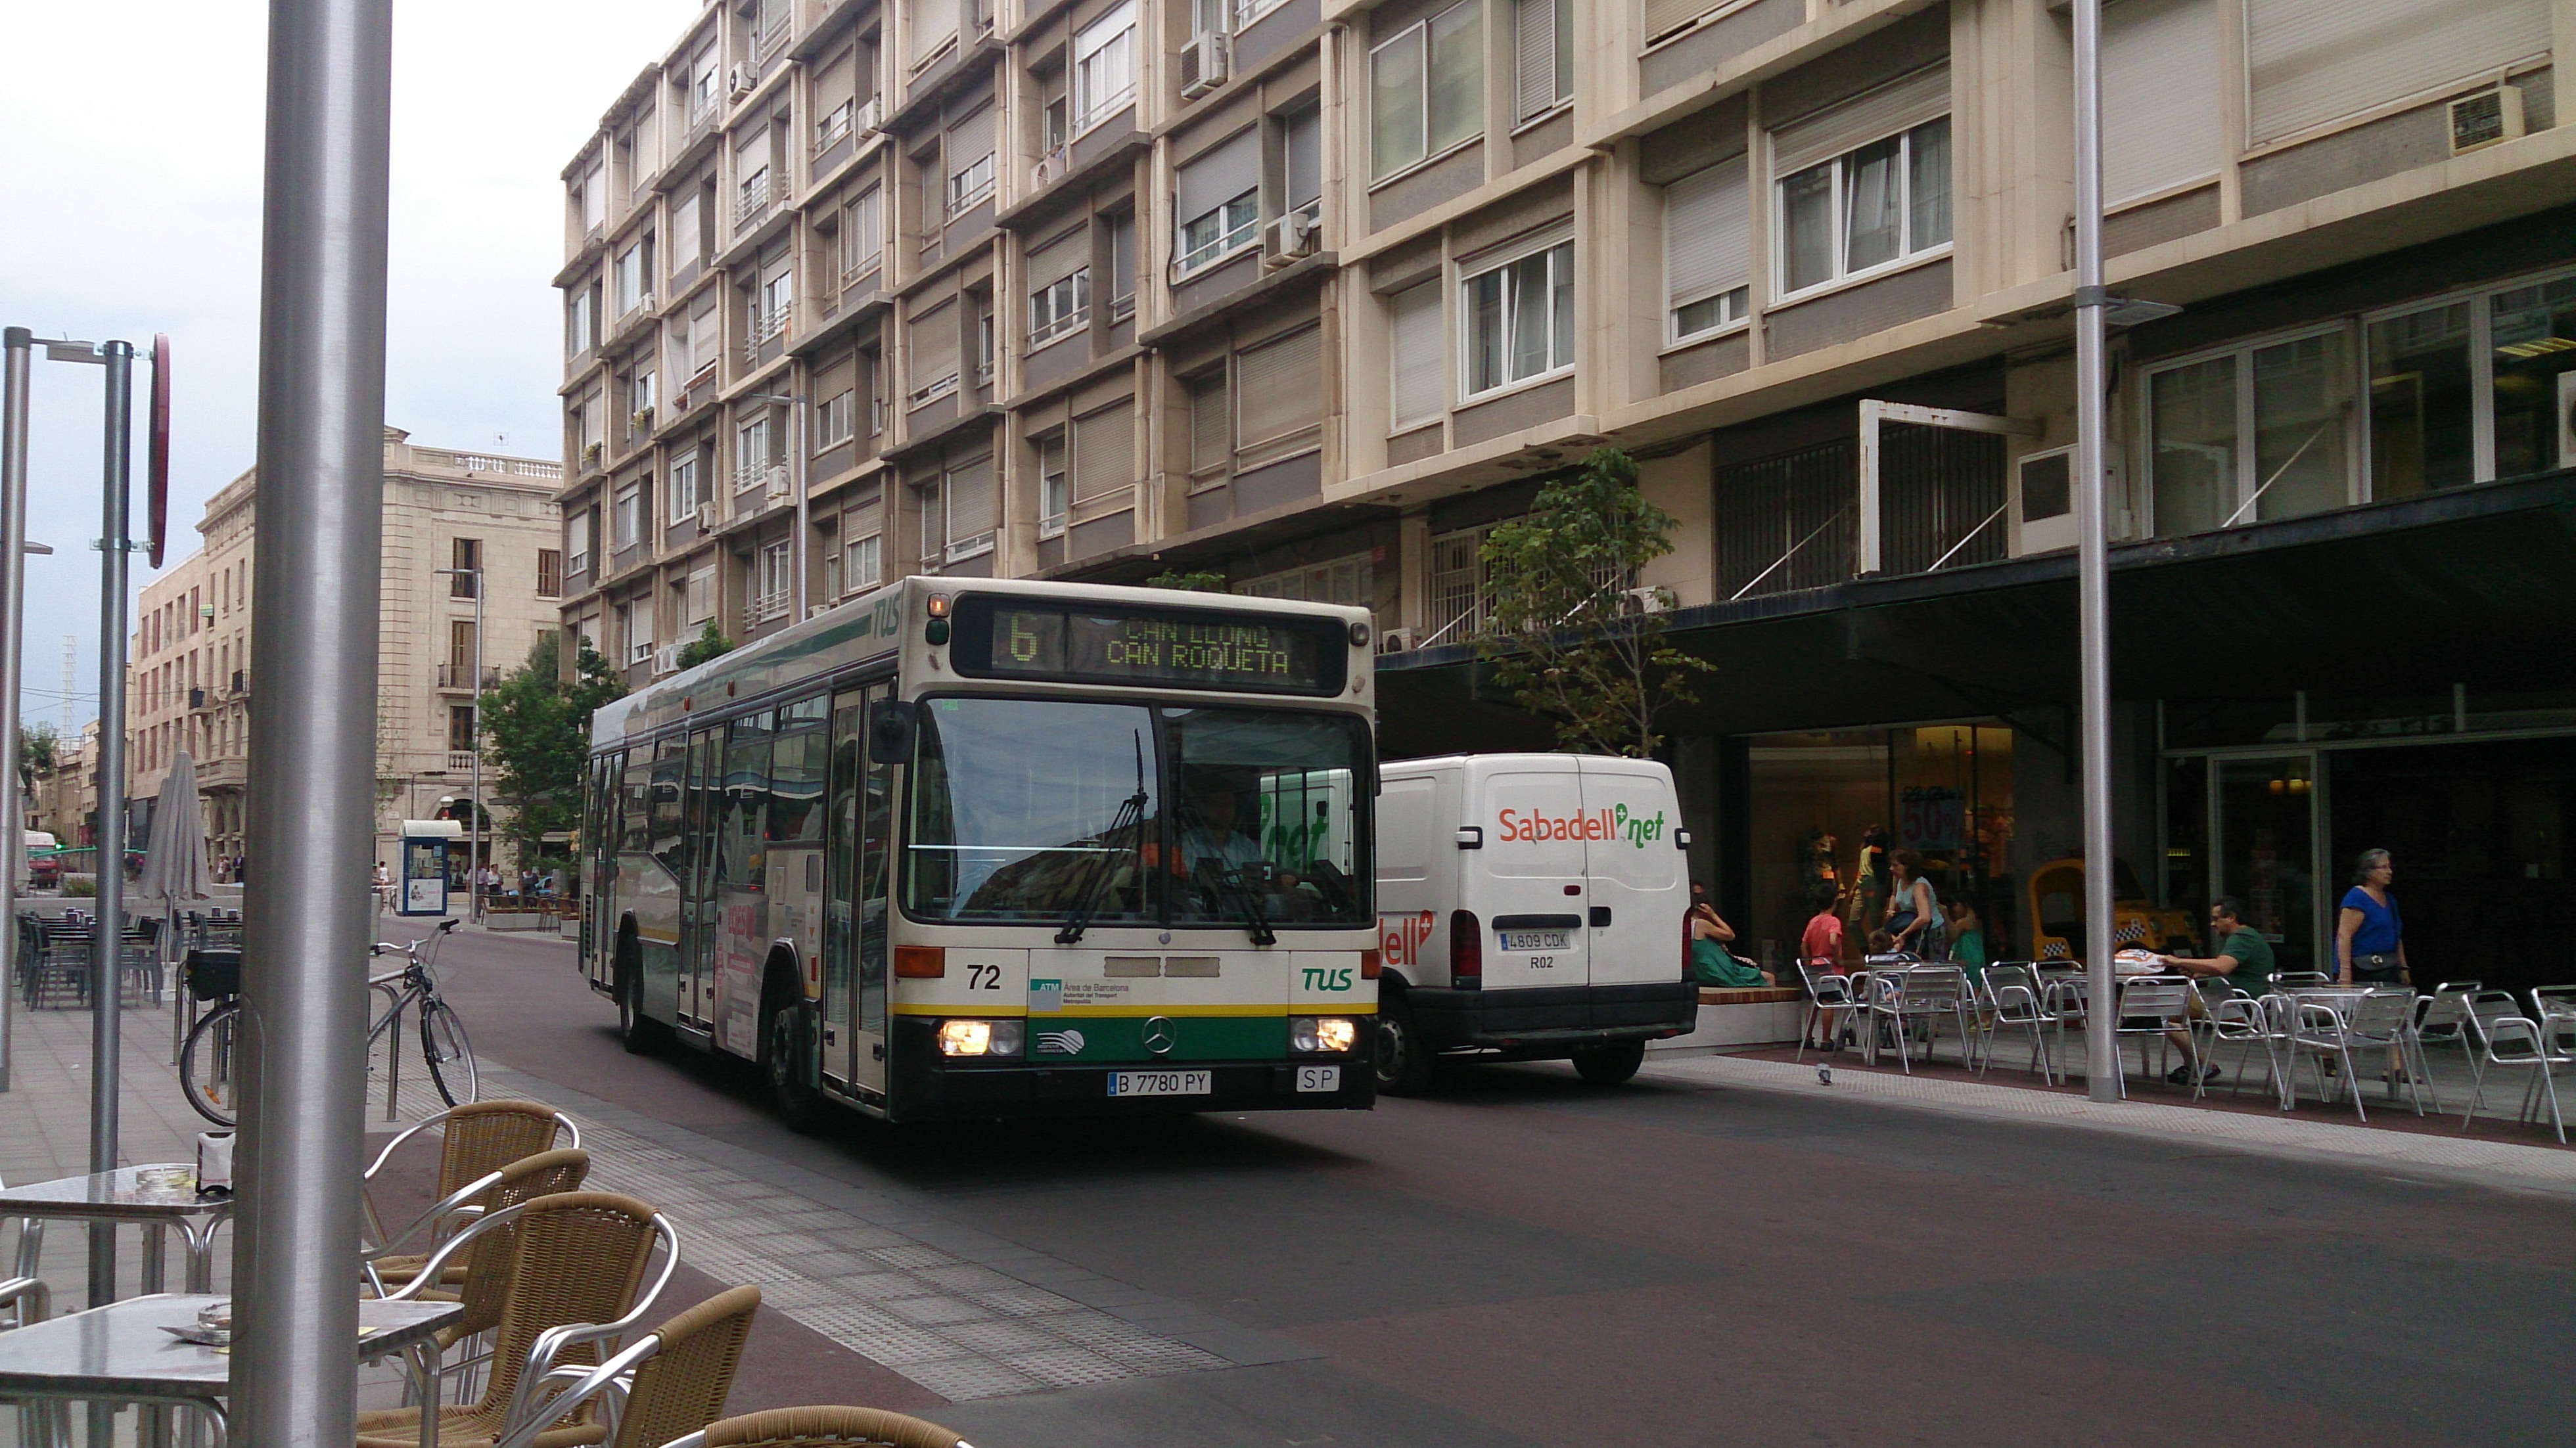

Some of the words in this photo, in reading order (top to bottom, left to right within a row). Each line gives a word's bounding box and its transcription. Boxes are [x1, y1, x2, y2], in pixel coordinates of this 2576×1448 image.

[873, 591, 901, 640] TUS
[1011, 611, 1037, 662] 6
[1107, 640, 1159, 666] CAN
[1172, 643, 1288, 673] ROQUETA
[1498, 808, 1616, 842] Sabadell
[1510, 934, 1540, 948] 4809
[1544, 934, 1567, 947] CDK
[1530, 957, 1553, 969] R02
[967, 964, 1001, 990] 72
[1040, 983, 1060, 991] ATM
[1093, 984, 1129, 992] Barcelona
[1302, 968, 1353, 991] TUS
[1119, 1075, 1129, 1093] B
[1137, 1074, 1179, 1093] 7780
[1185, 1074, 1206, 1091] PY
